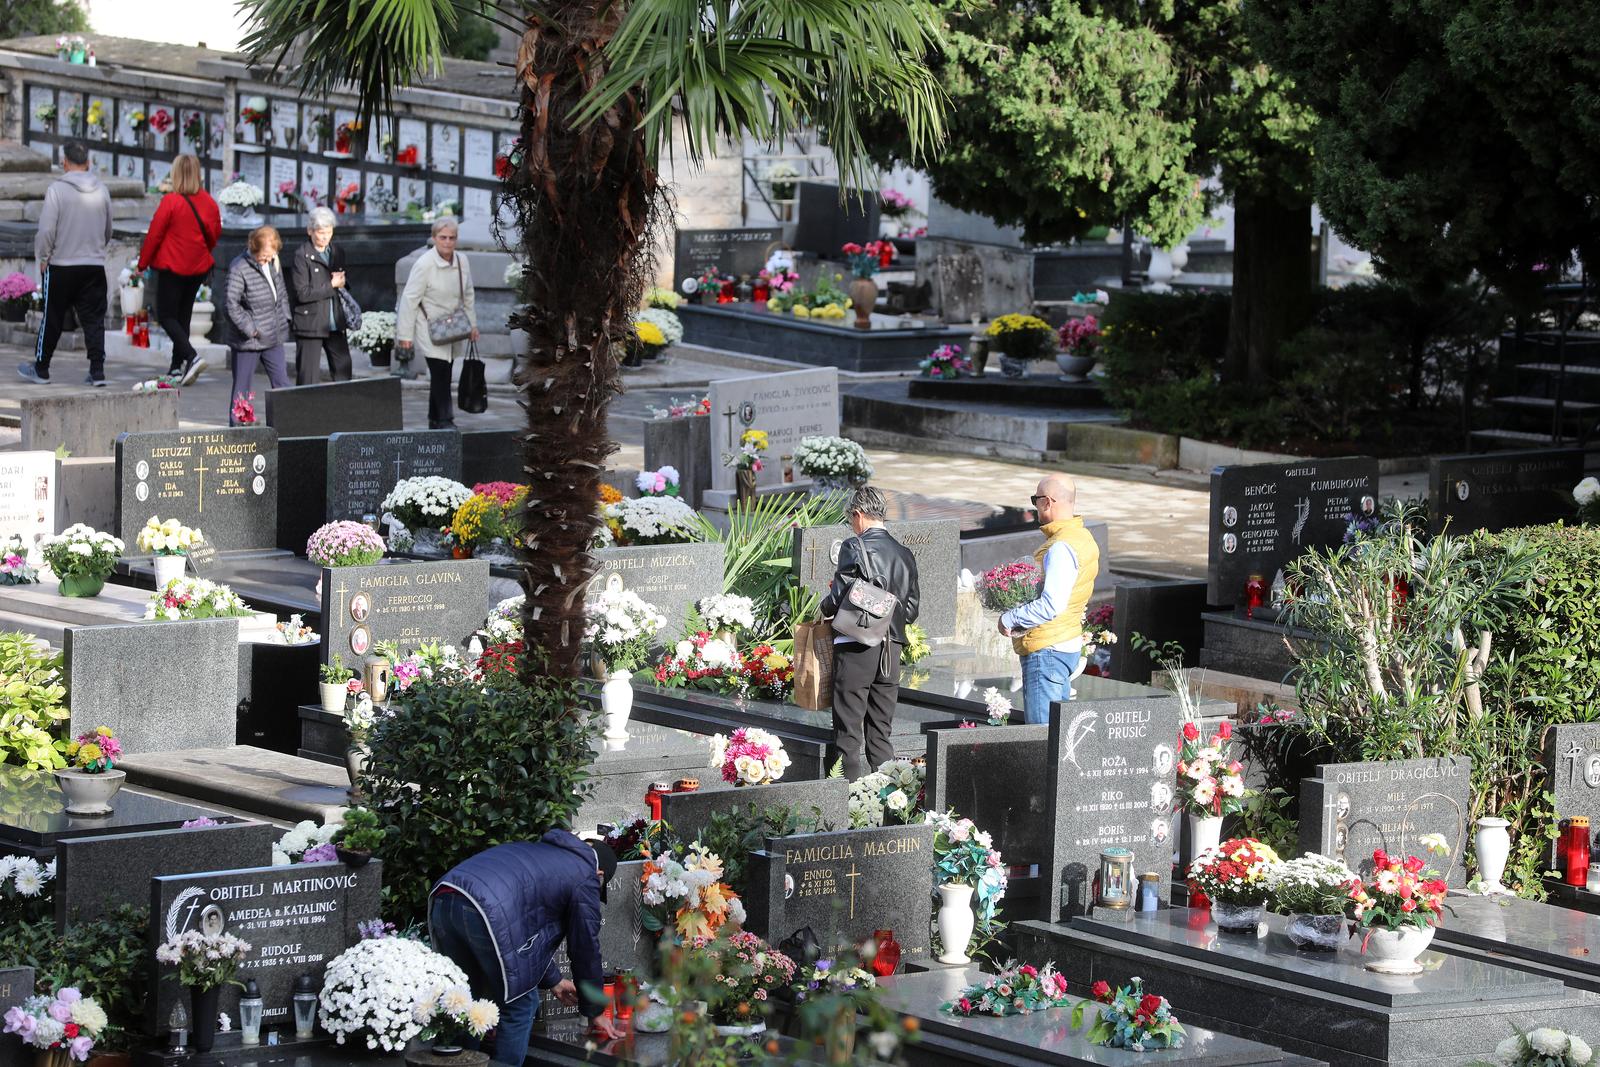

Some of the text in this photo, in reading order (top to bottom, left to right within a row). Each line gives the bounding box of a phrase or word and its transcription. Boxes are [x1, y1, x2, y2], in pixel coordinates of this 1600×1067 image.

[180, 434, 224, 444] OBITELJI
[152, 446, 192, 458] LISTUZZI
[360, 446, 374, 456] PIN
[418, 444, 446, 454] MARIN
[160, 461, 183, 470] CARLO
[220, 458, 242, 466] JURAJ
[349, 460, 382, 470] GIULIANO
[1285, 467, 1317, 477] OBITELJI
[164, 482, 177, 490] IDA
[222, 480, 239, 488] JELA
[348, 481, 380, 489] GILBERTA
[1244, 482, 1277, 496] BENČIĆ
[1310, 476, 1369, 492] KUMBUROVIĆ
[1326, 497, 1350, 506] PETAR
[1249, 502, 1274, 512] JAKOV
[1242, 530, 1280, 539] GENOVEFA
[604, 558, 644, 570] OBITELJ
[360, 572, 462, 588] FAMIGLIA GLAVINA
[646, 576, 669, 584] JOSIP
[388, 594, 433, 605] FERRUCCIO
[400, 628, 420, 637] JOLE
[1105, 710, 1150, 724] OBITELJ
[1108, 724, 1147, 740] PRUSIĆ
[1102, 756, 1127, 768] ROŽA
[1336, 770, 1380, 784] OBITELJ
[1102, 791, 1124, 800] RIKO
[1386, 792, 1406, 802] MILE
[1098, 826, 1124, 836] BORIS
[785, 838, 920, 864] FAMIGLIA MACHIN
[804, 869, 833, 881] ENNIO
[210, 873, 358, 902] OBITELJ MARTINOVIĆ
[228, 908, 272, 922] AMEDEA
[284, 900, 337, 916] KATALINIĆ
[256, 920, 267, 929] VII
[298, 916, 309, 925] VII
[261, 944, 302, 958] RUDOLF
